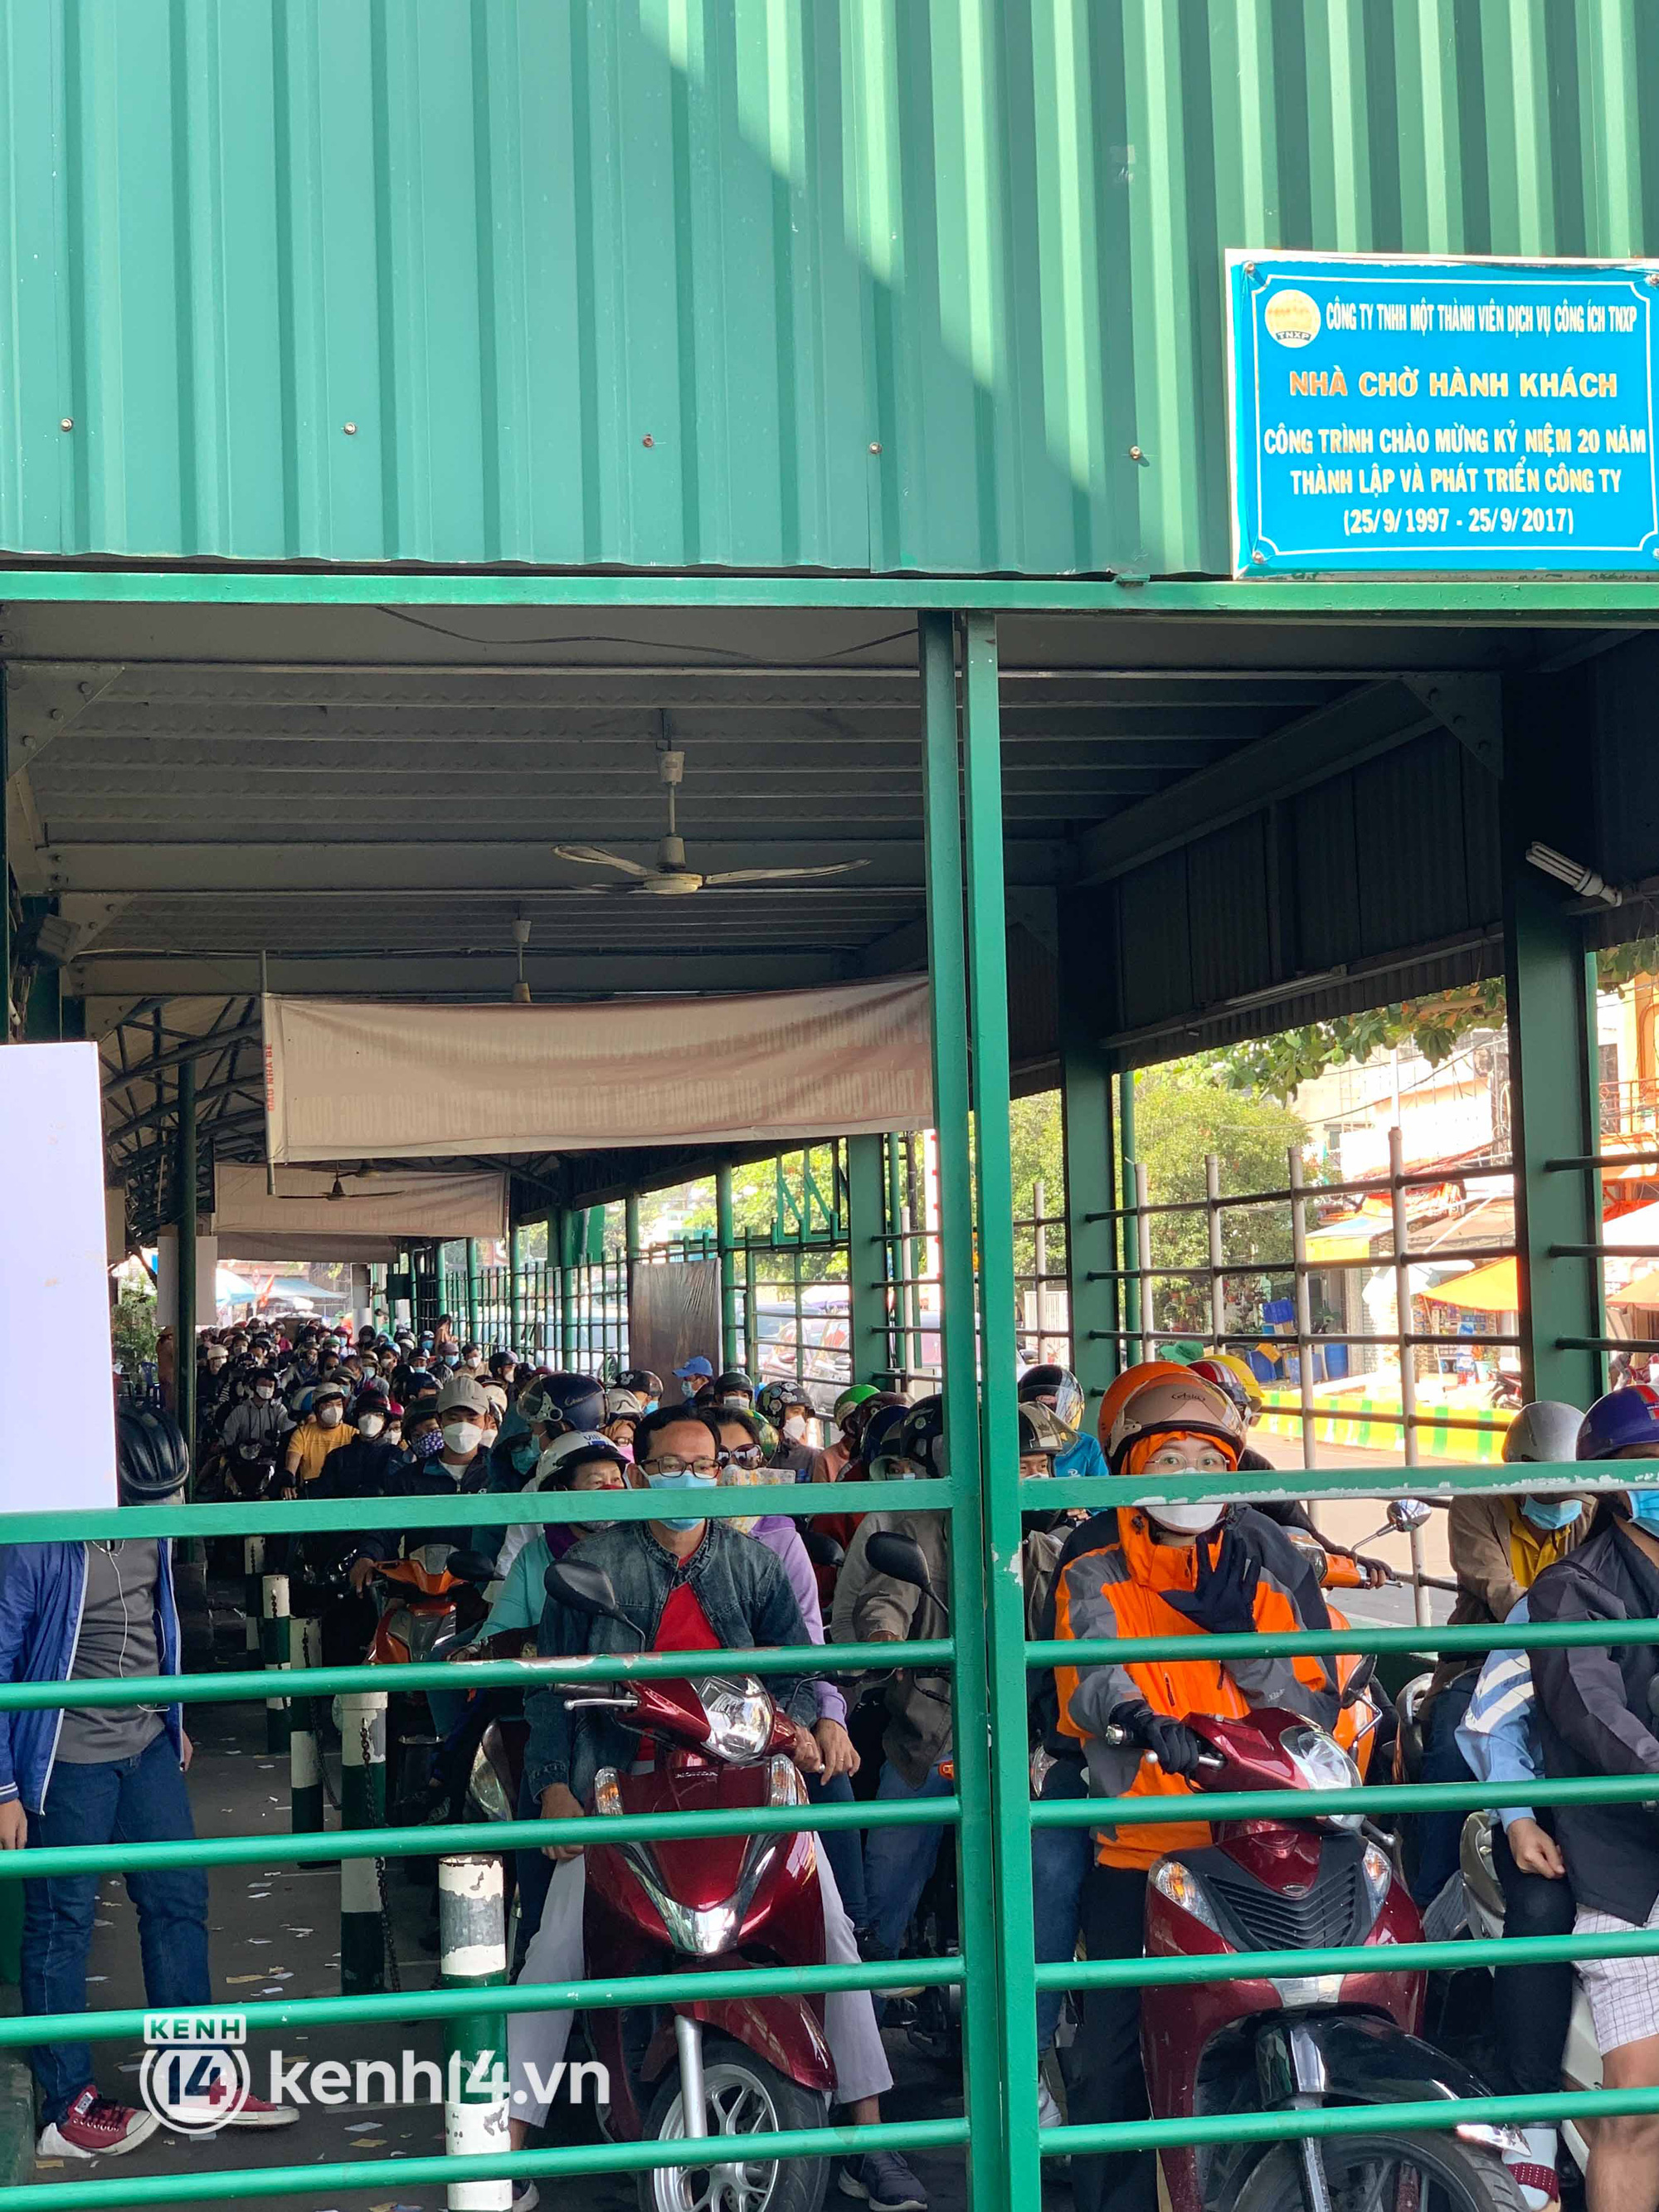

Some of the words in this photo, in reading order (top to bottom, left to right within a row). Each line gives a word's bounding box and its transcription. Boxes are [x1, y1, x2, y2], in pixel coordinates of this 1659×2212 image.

[1326, 295, 1357, 331] CÔNG
[1359, 302, 1374, 331] TY
[1376, 302, 1407, 331] TNHH
[1410, 296, 1433, 337] MỘT
[1438, 297, 1475, 332] THÀNH
[1477, 297, 1504, 332] VIÊN
[1506, 304, 1533, 339] DỊCH
[1536, 305, 1551, 339] VỤ
[1554, 298, 1584, 333] CÔNG
[1587, 299, 1606, 333] ÍCH
[1608, 305, 1637, 333] TNXP
[1277, 331, 1310, 341] TNXP
[1290, 364, 1348, 397] NHÀ
[1359, 365, 1420, 397] CHỜ
[1429, 366, 1509, 397] HÀNH
[1520, 366, 1618, 397] KHÁCH
[1264, 421, 1314, 455] CÔNG
[1318, 421, 1374, 454] TRÌNH
[1379, 421, 1429, 454] CHÀO
[1435, 421, 1489, 454] MỪNG
[1494, 419, 1518, 454] KỶ
[1525, 421, 1572, 458] NIỆM
[1577, 428, 1601, 454] 20
[1605, 424, 1647, 454] NĂM
[1290, 463, 1354, 495] THÀNH
[1359, 461, 1396, 499] LẬP
[1399, 461, 1425, 493] VÀ
[1430, 461, 1478, 493] PHÁT
[1483, 455, 1540, 493] TRIỂN
[1545, 461, 1594, 493] CÔNG
[1598, 469, 1622, 493] TY
[1467, 507, 1574, 535] 25/9/2017)
